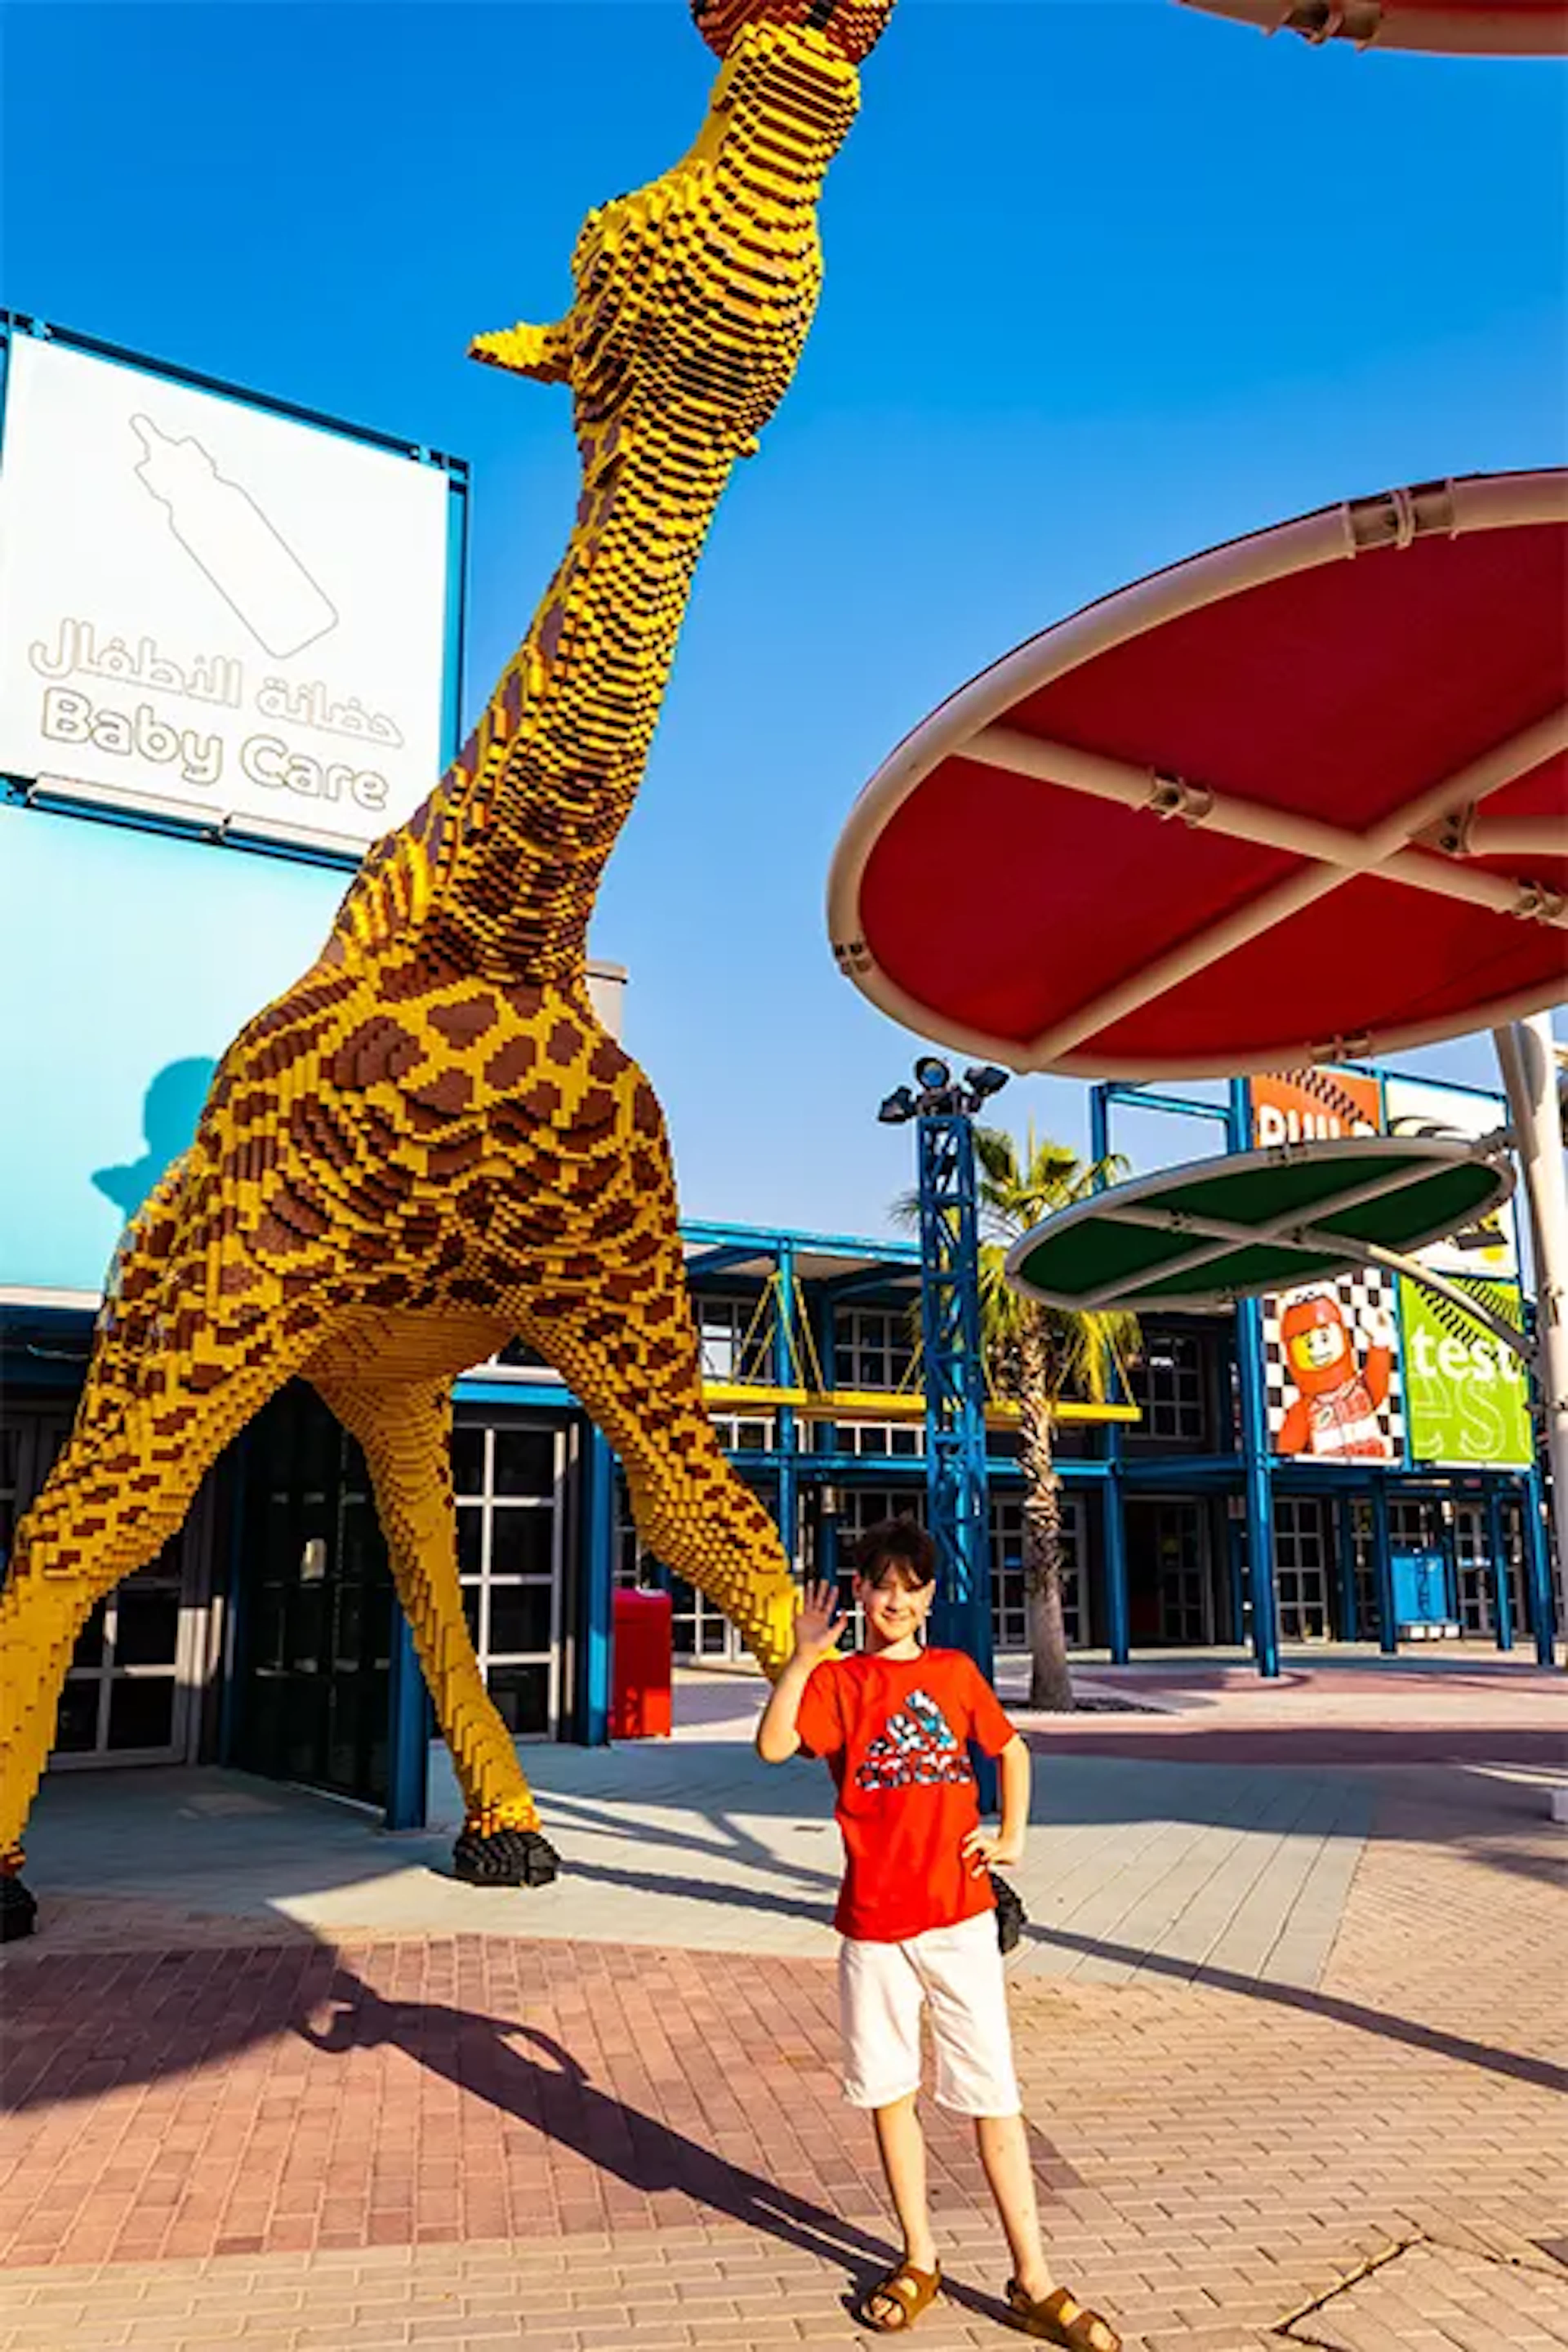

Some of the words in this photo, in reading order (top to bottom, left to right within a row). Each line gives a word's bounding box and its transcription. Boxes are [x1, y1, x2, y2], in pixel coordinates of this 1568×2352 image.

[41, 687, 223, 785] Baby
[240, 734, 389, 810] Care
[255, 676, 405, 748] حضانة
